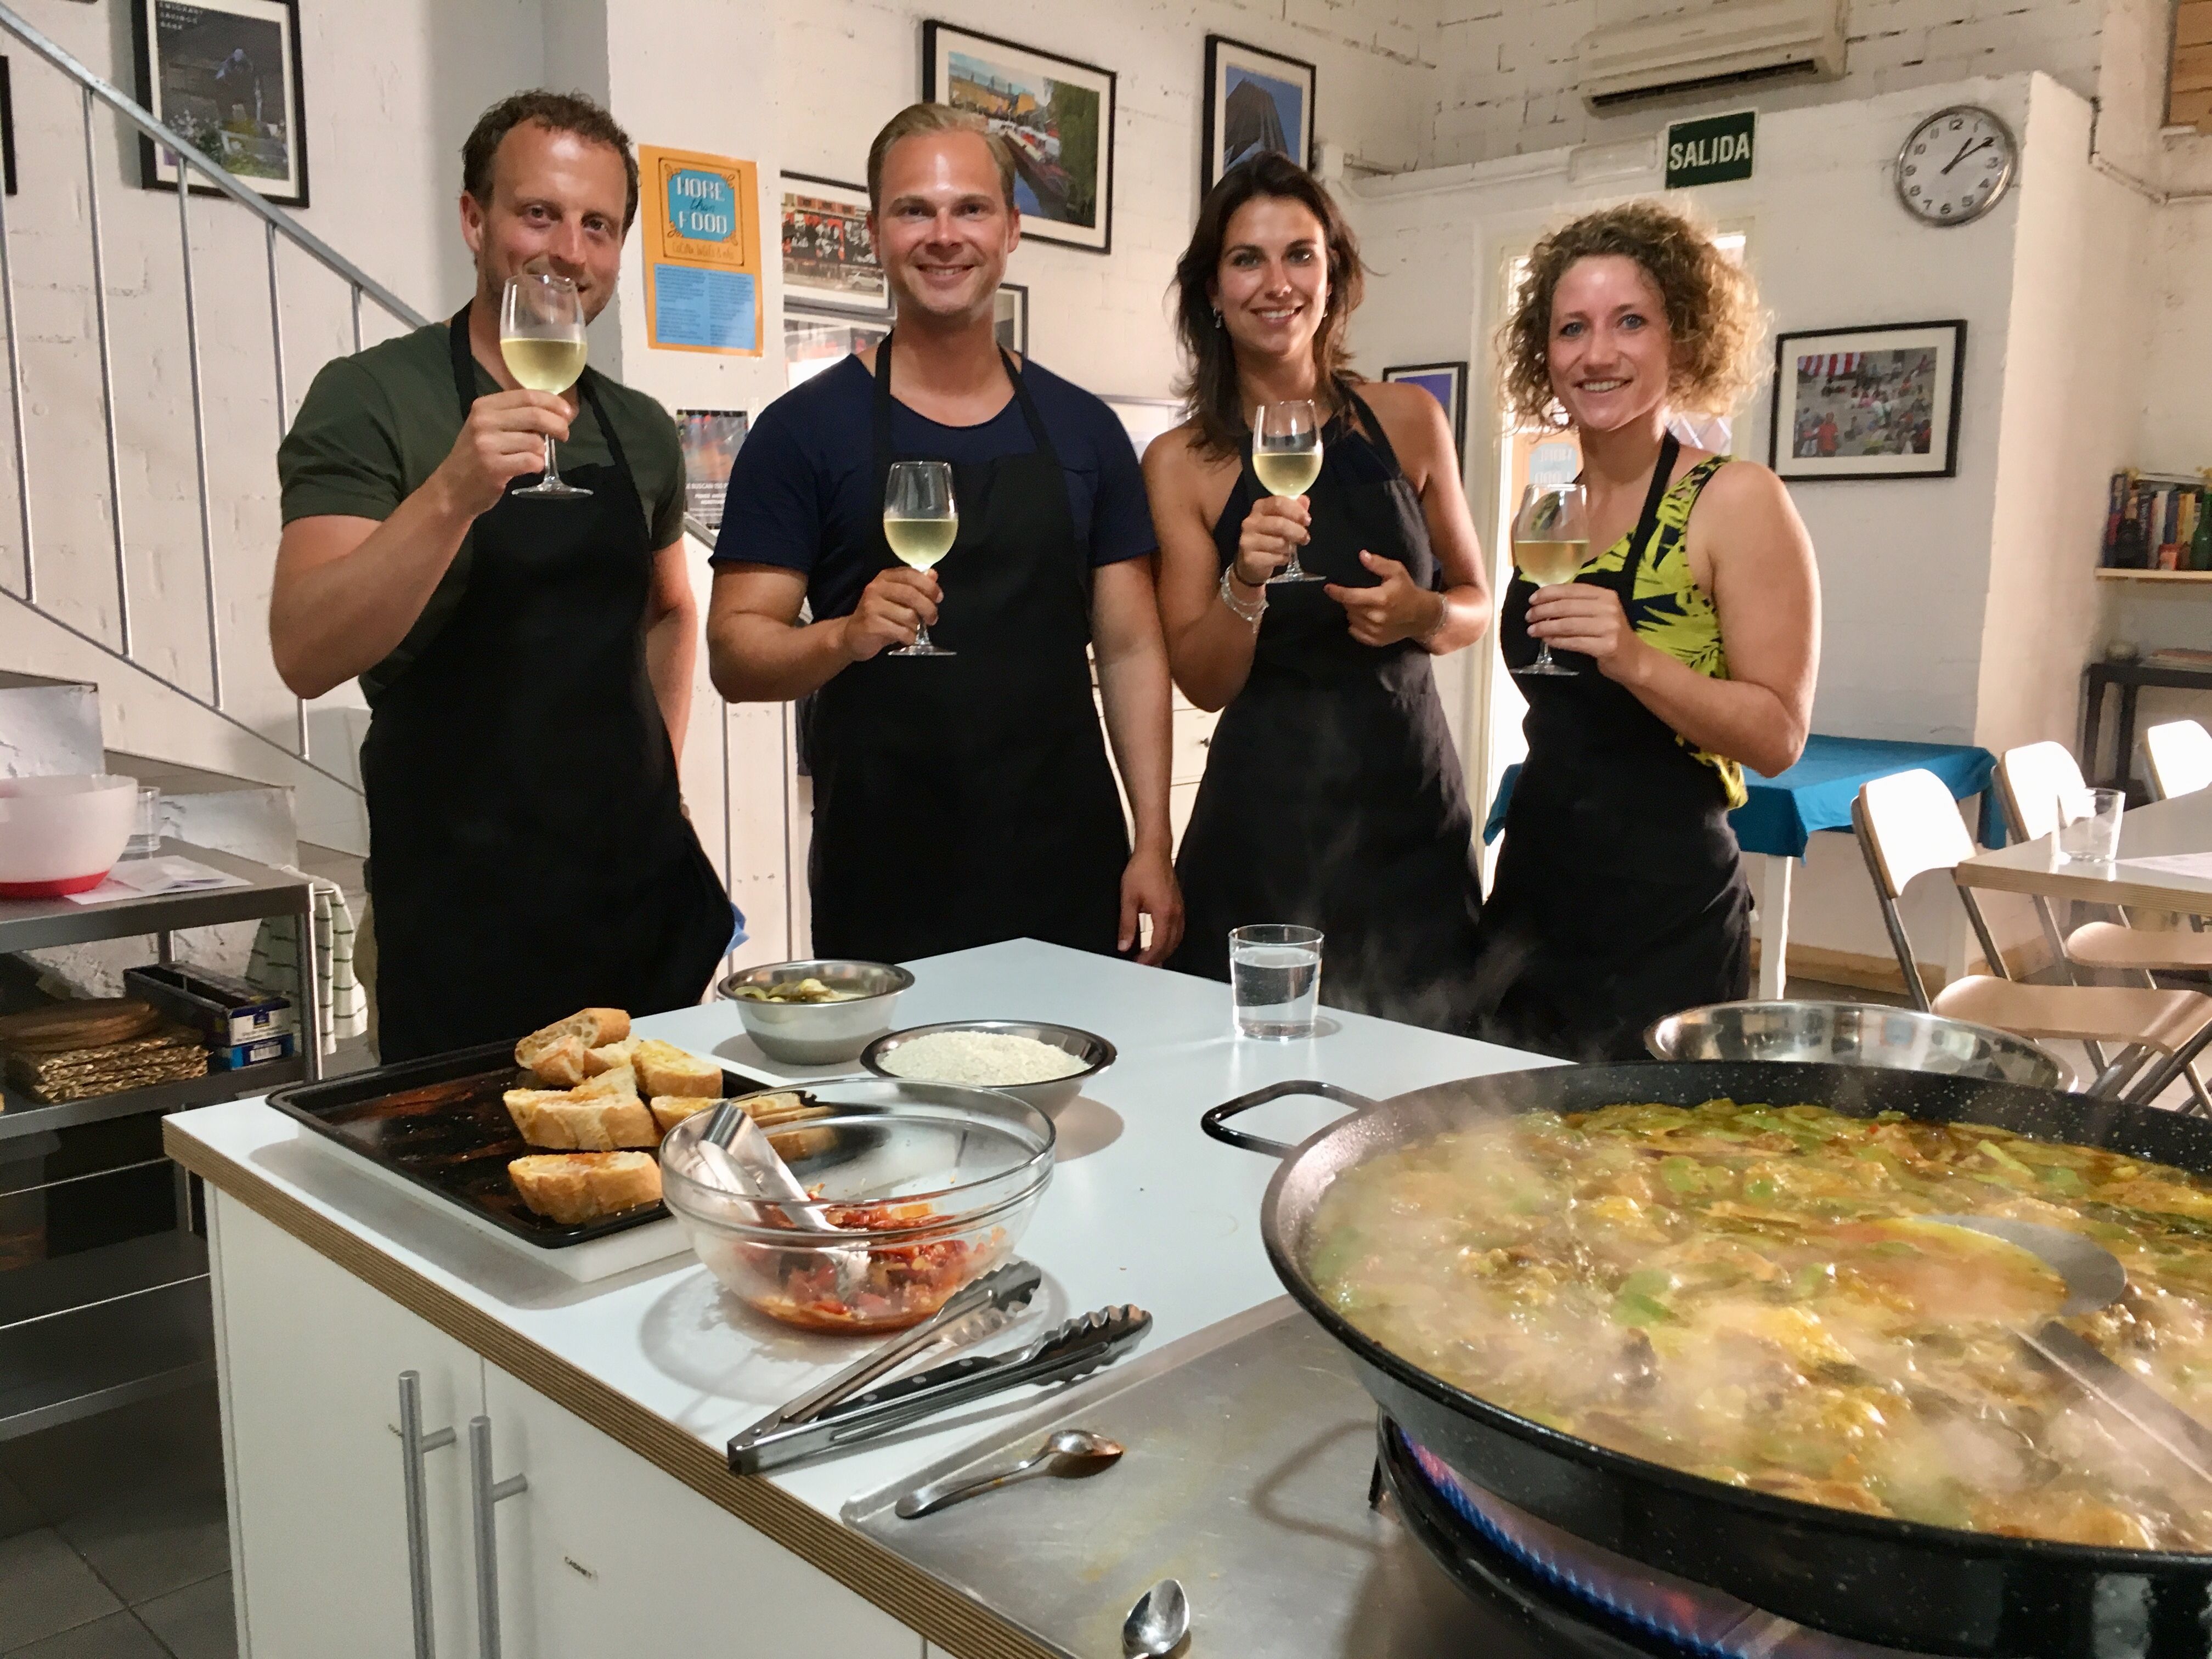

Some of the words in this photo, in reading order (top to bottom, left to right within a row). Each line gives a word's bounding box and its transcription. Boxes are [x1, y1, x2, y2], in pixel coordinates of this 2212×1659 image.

[1669, 132, 1750, 171] SALIDA
[1986, 156, 1998, 169] 3
[1905, 165, 1917, 176] 9
[676, 176, 725, 201] MORE
[1923, 199, 1933, 210] 7
[1962, 195, 1974, 207] 5
[1940, 203, 1951, 215] 6
[678, 211, 727, 234] FOOD
